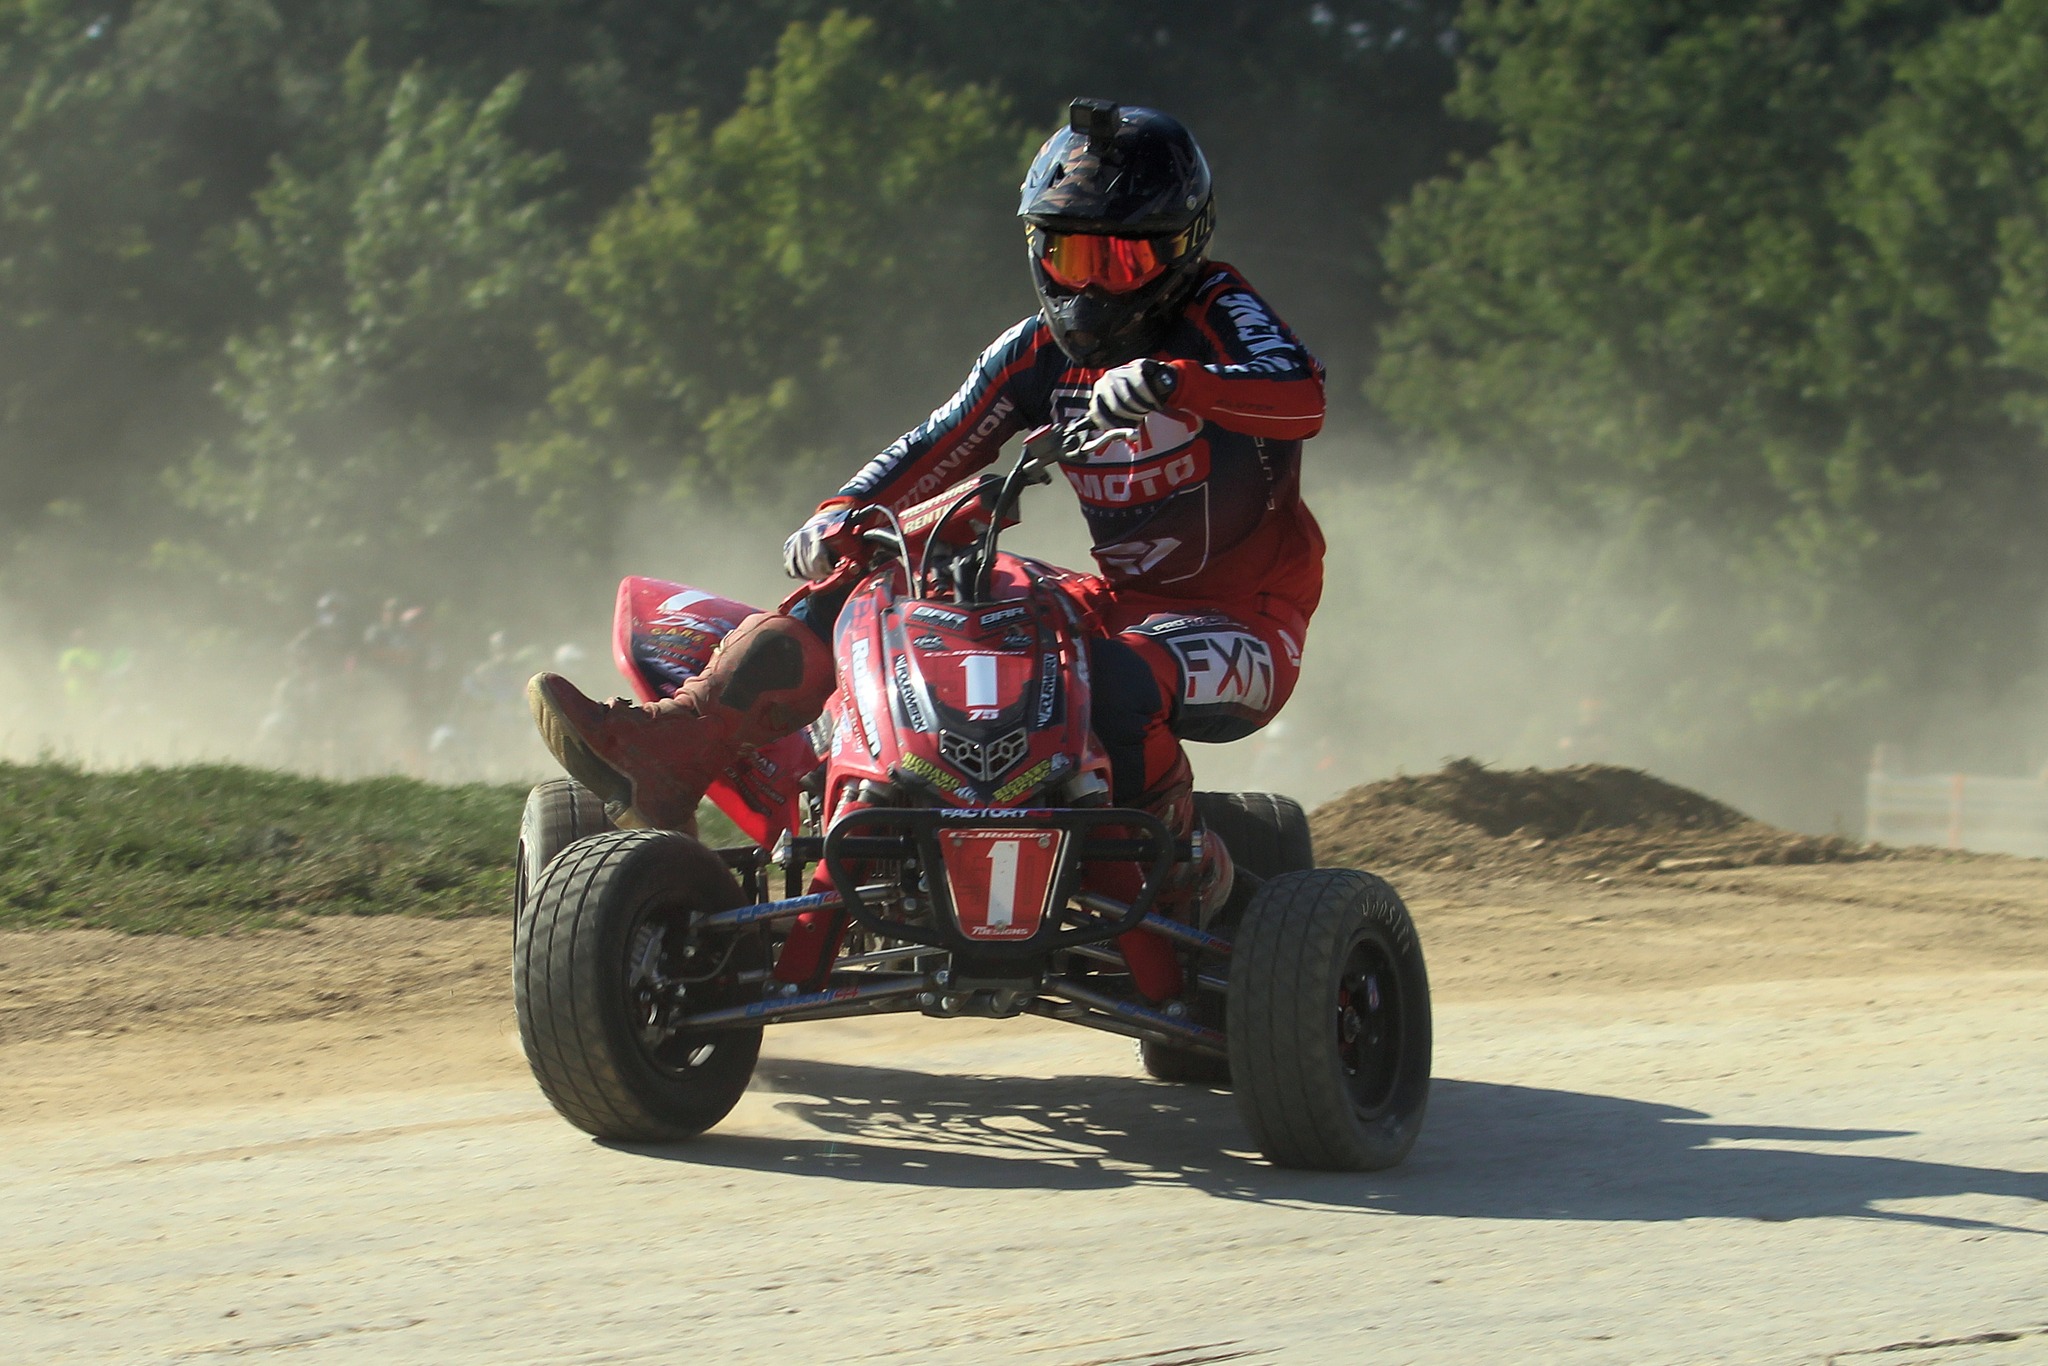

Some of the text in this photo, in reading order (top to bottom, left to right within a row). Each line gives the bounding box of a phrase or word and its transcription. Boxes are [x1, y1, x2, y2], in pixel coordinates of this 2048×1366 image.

[1067, 454, 1196, 502] MOTO
[981, 607, 1026, 625] BAR
[958, 655, 998, 707] 1
[940, 808, 1029, 818] FACTORY
[986, 840, 1020, 927] 1
